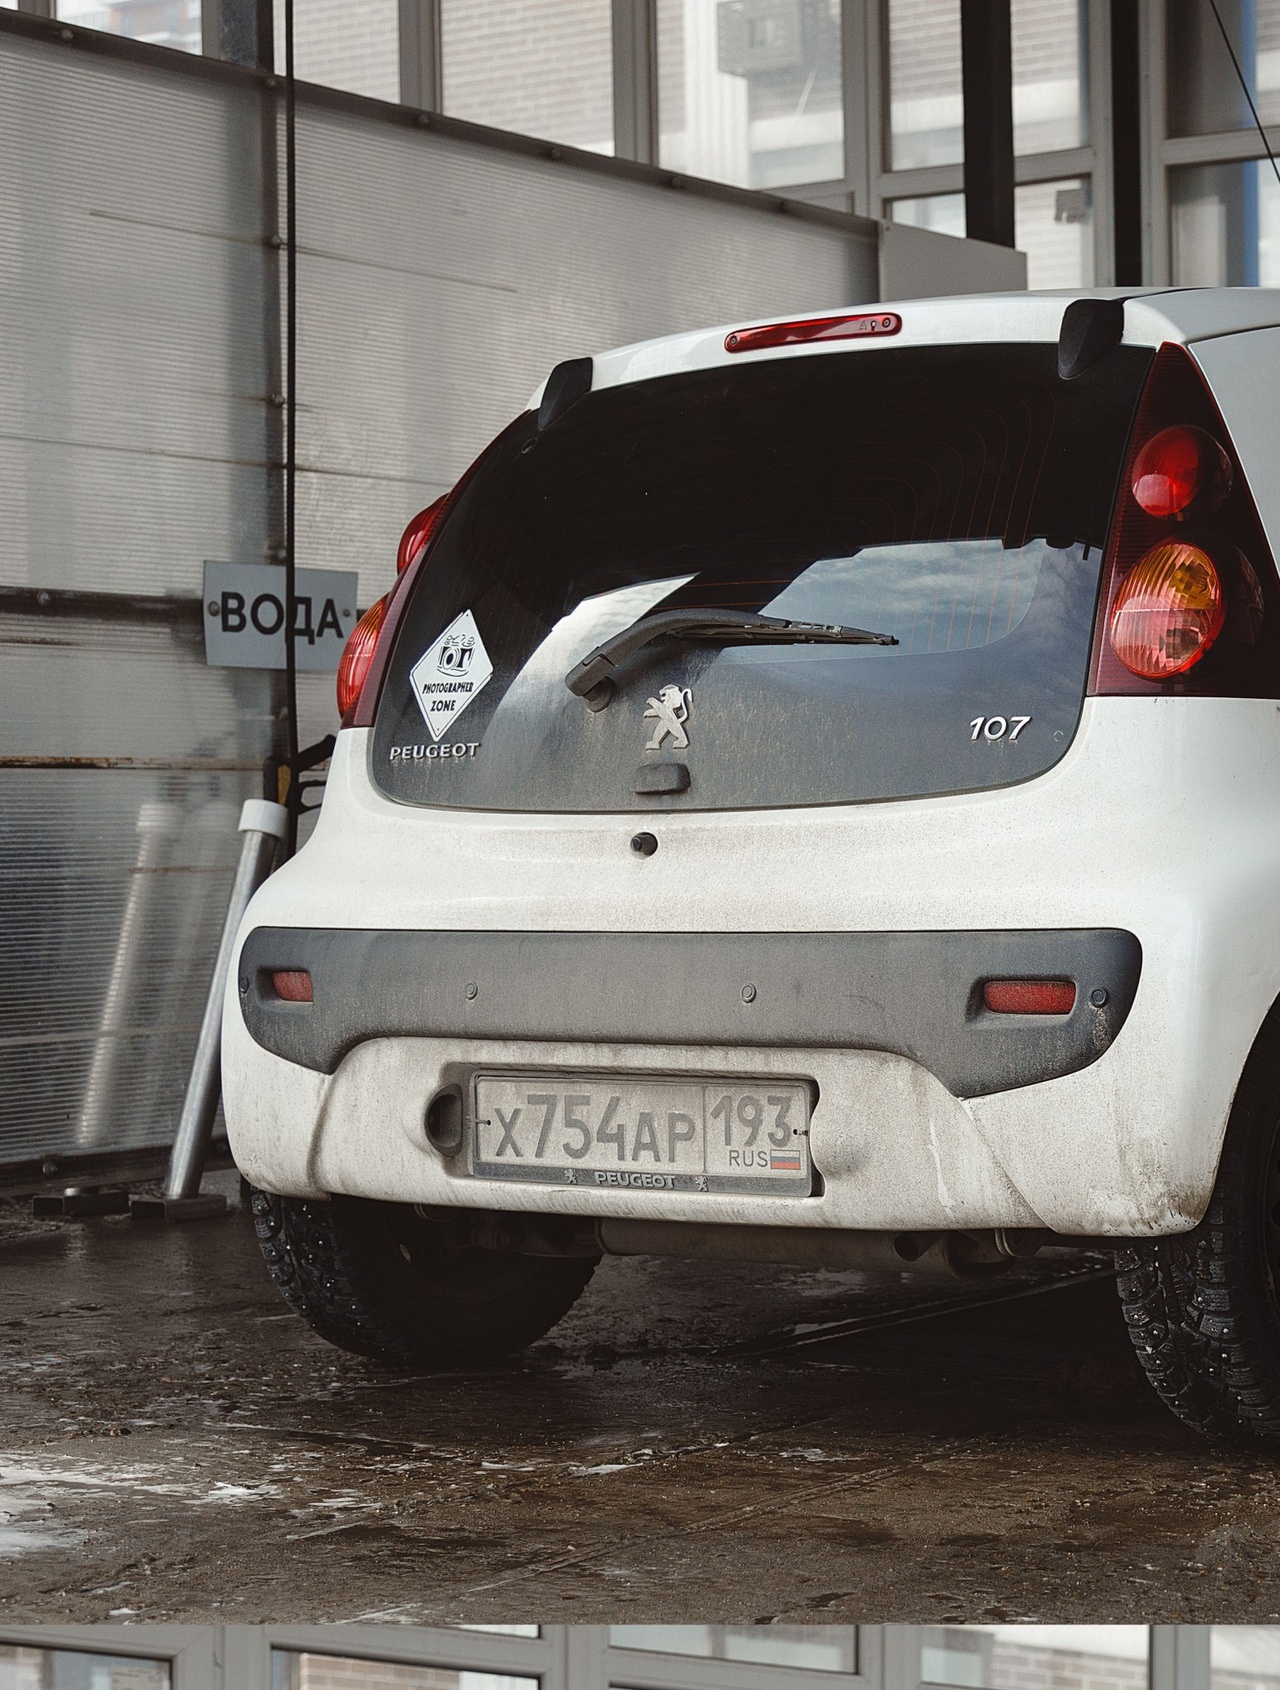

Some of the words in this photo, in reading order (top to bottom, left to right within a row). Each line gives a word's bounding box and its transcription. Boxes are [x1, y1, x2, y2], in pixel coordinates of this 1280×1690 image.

[221, 591, 344, 645] ВОДА
[422, 682, 474, 695] PHOTOGRAPHER
[430, 700, 457, 712] ZONE
[970, 716, 1032, 741] 107
[389, 742, 480, 760] PEUGEOT
[711, 1094, 793, 1148] 193
[728, 1149, 768, 1168] RUS
[594, 1171, 676, 1189] PEUGEOT
